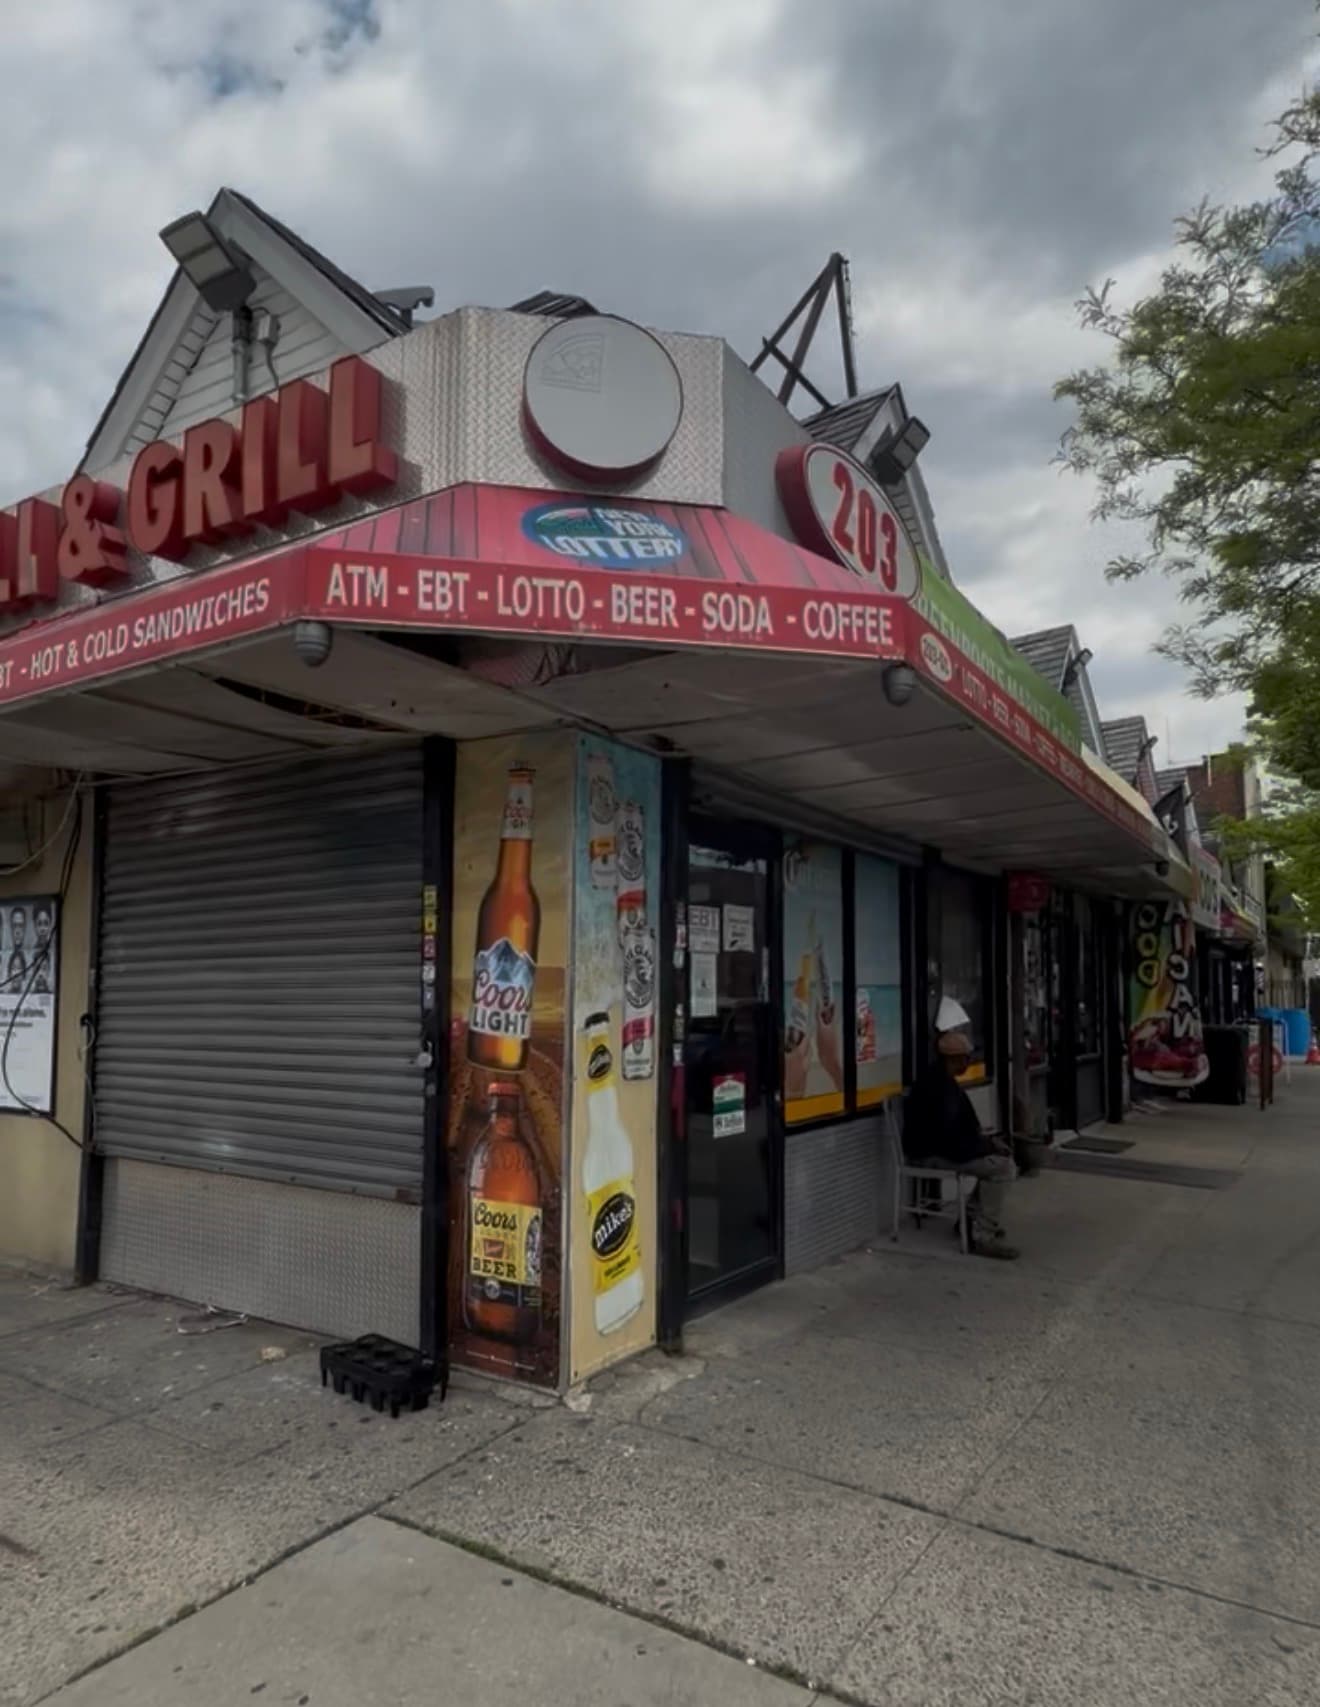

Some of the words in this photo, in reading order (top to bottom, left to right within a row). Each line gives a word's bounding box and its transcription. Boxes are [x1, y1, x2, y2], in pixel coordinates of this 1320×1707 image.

[58, 473, 120, 582] &
[128, 354, 390, 556] GRILL
[593, 507, 650, 522] NEW
[604, 518, 675, 538] YORK
[832, 461, 898, 593] 203
[539, 534, 683, 559] LOTTERY
[326, 562, 389, 608] ATM
[417, 569, 470, 614] EBT
[497, 575, 585, 622] LOTTO
[610, 583, 678, 628] BEER
[701, 591, 774, 636] SODA
[802, 600, 894, 647] COFFEE
[30, 643, 64, 680] HOT
[67, 640, 79, 669] &
[83, 623, 130, 664] COLD
[133, 578, 270, 649] SANDWICHES
[473, 1007, 528, 1036] LIGHT
[474, 1202, 517, 1231] Coors
[472, 1256, 517, 1278] BEER
